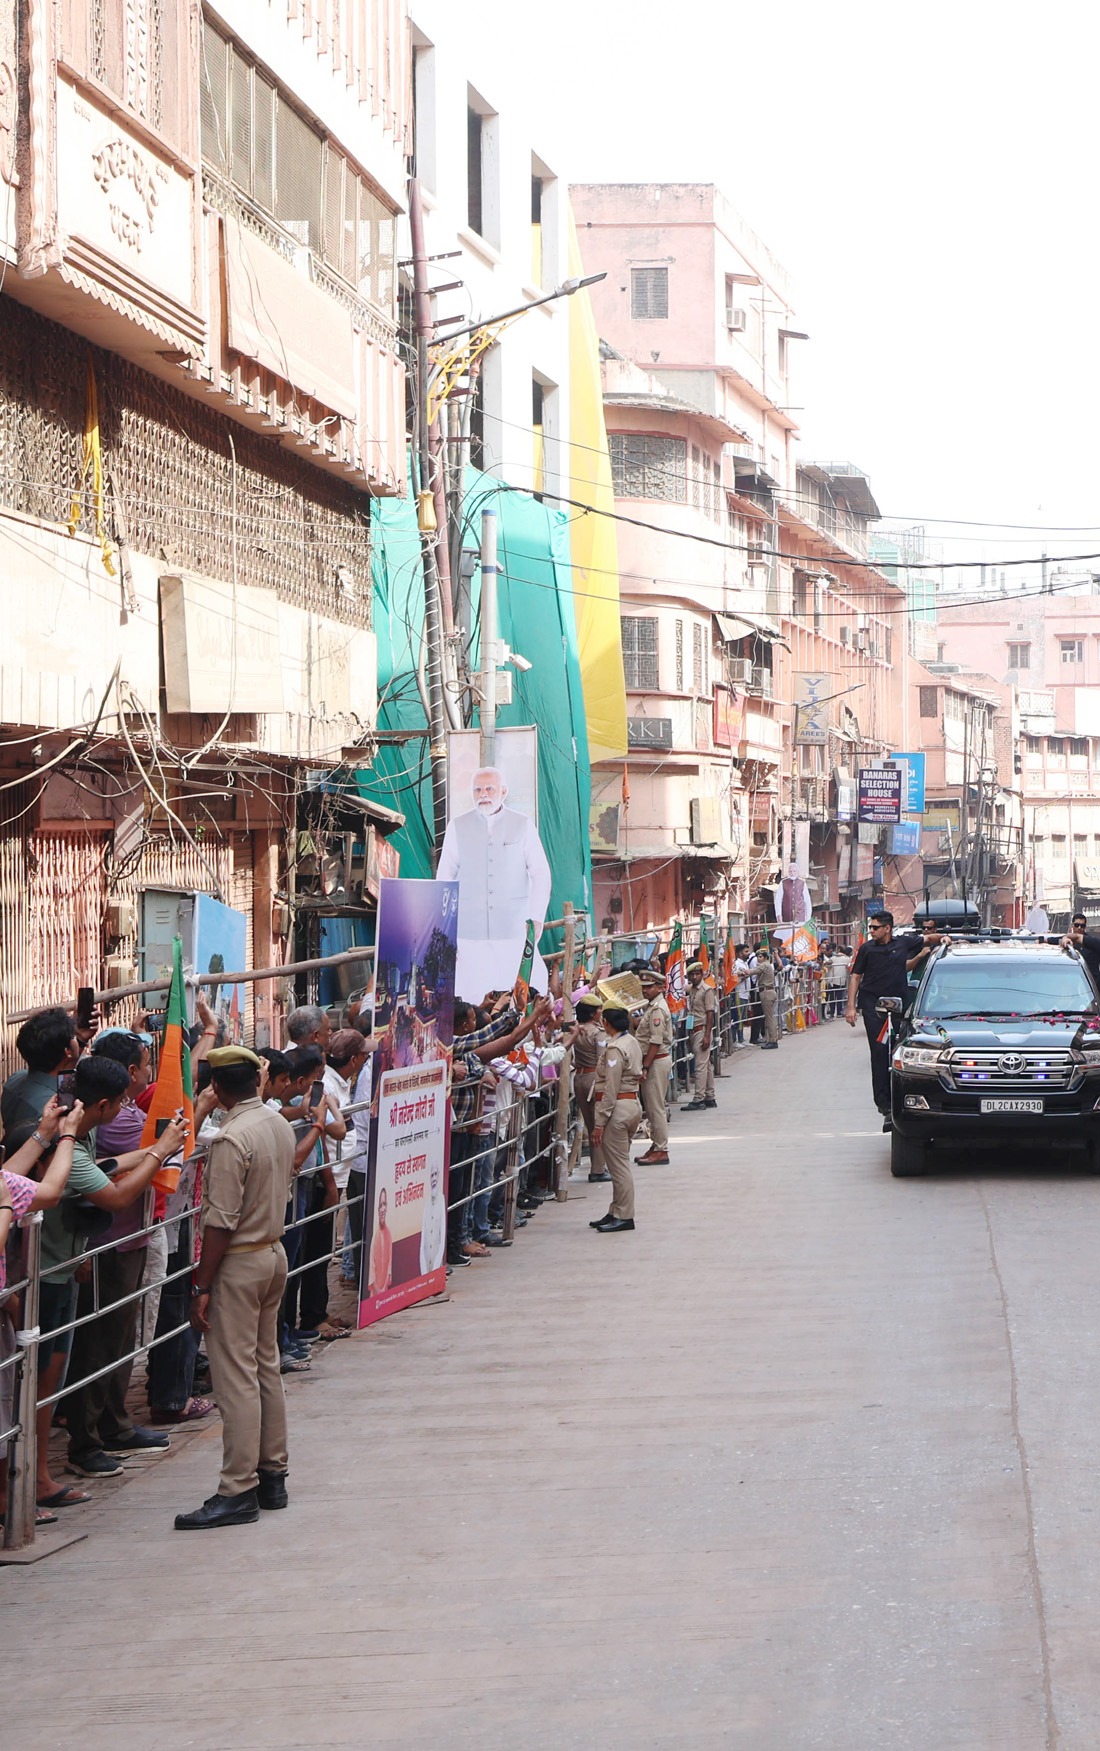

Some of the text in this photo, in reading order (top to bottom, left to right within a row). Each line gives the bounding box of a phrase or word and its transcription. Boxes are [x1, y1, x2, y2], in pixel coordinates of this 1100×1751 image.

[862, 771, 898, 780] BANARAS
[860, 780, 900, 789] SELECTION
[867, 789, 893, 798] HOUSE
[389, 1092, 436, 1128] श्री नरेन्द्र मोदी जी
[986, 1101, 1042, 1111] DL2CAX2930
[394, 1153, 427, 1184] हृदय से स्वागत
[394, 1186, 403, 1208] एवं
